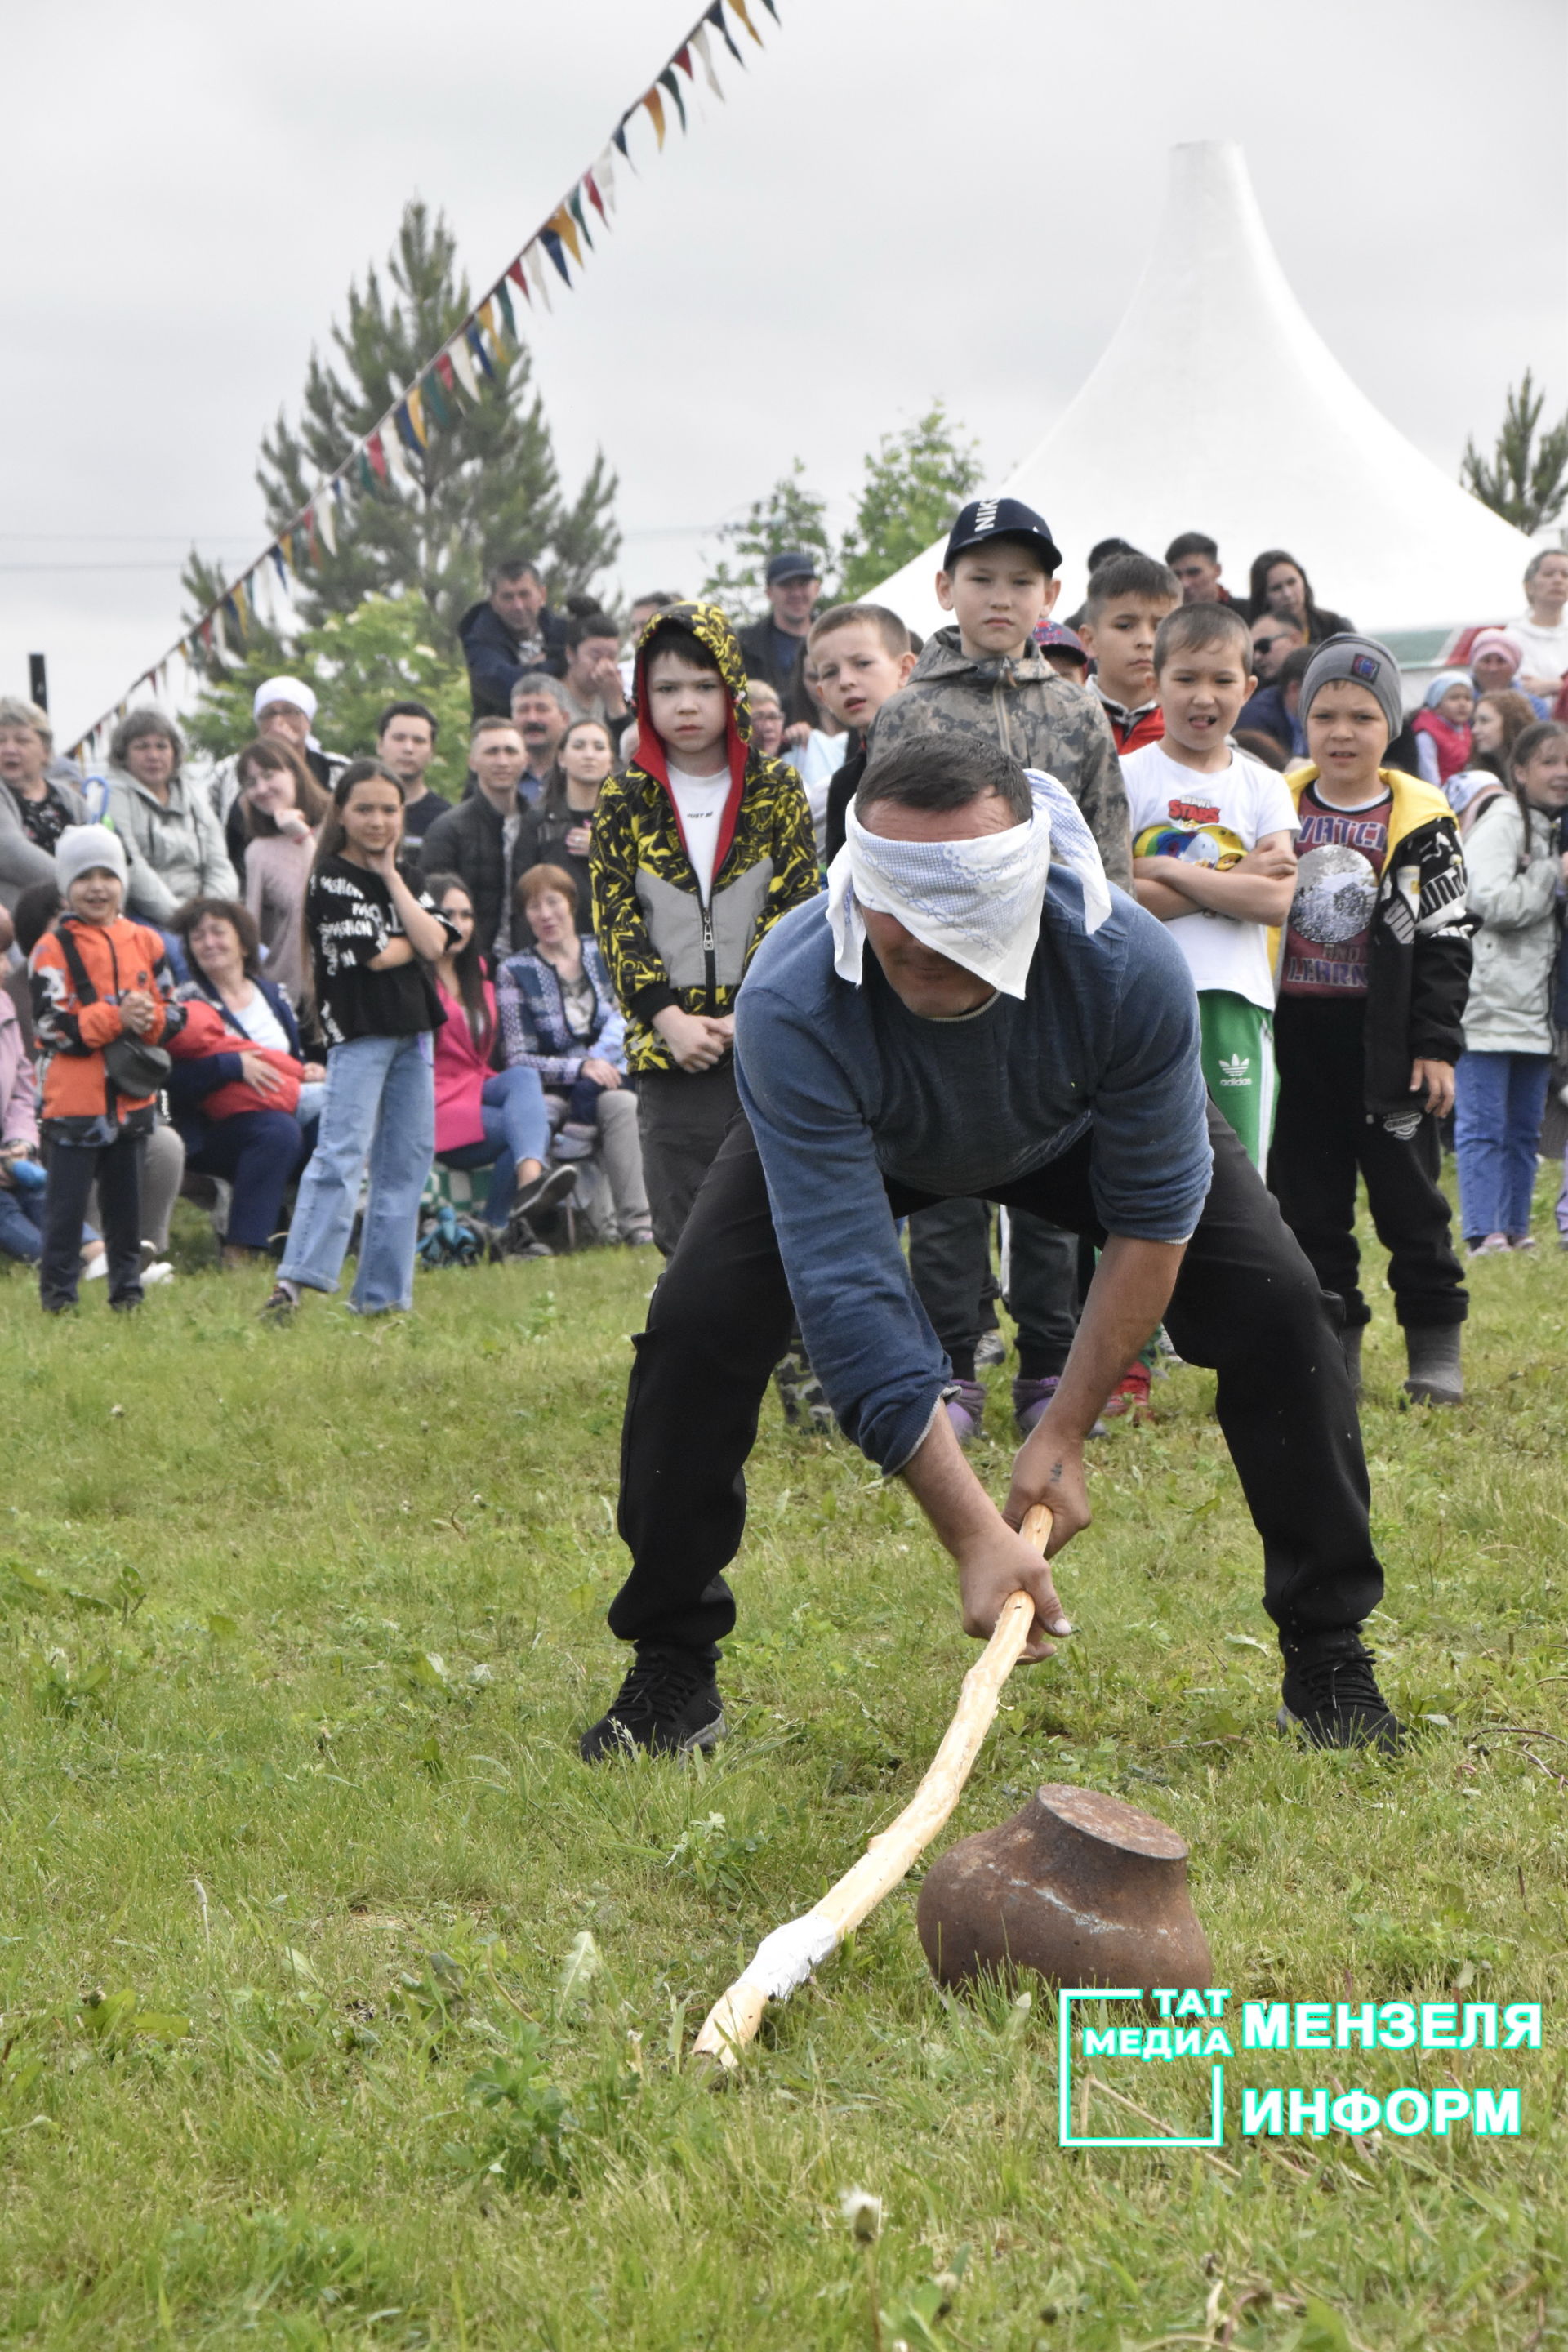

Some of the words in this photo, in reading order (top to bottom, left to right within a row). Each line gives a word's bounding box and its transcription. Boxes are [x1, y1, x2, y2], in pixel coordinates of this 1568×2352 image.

[974, 497, 1000, 532] NIK
[1168, 799, 1221, 824] STARS
[1287, 956, 1369, 988] LEARN
[1220, 1078, 1252, 1086] adidas
